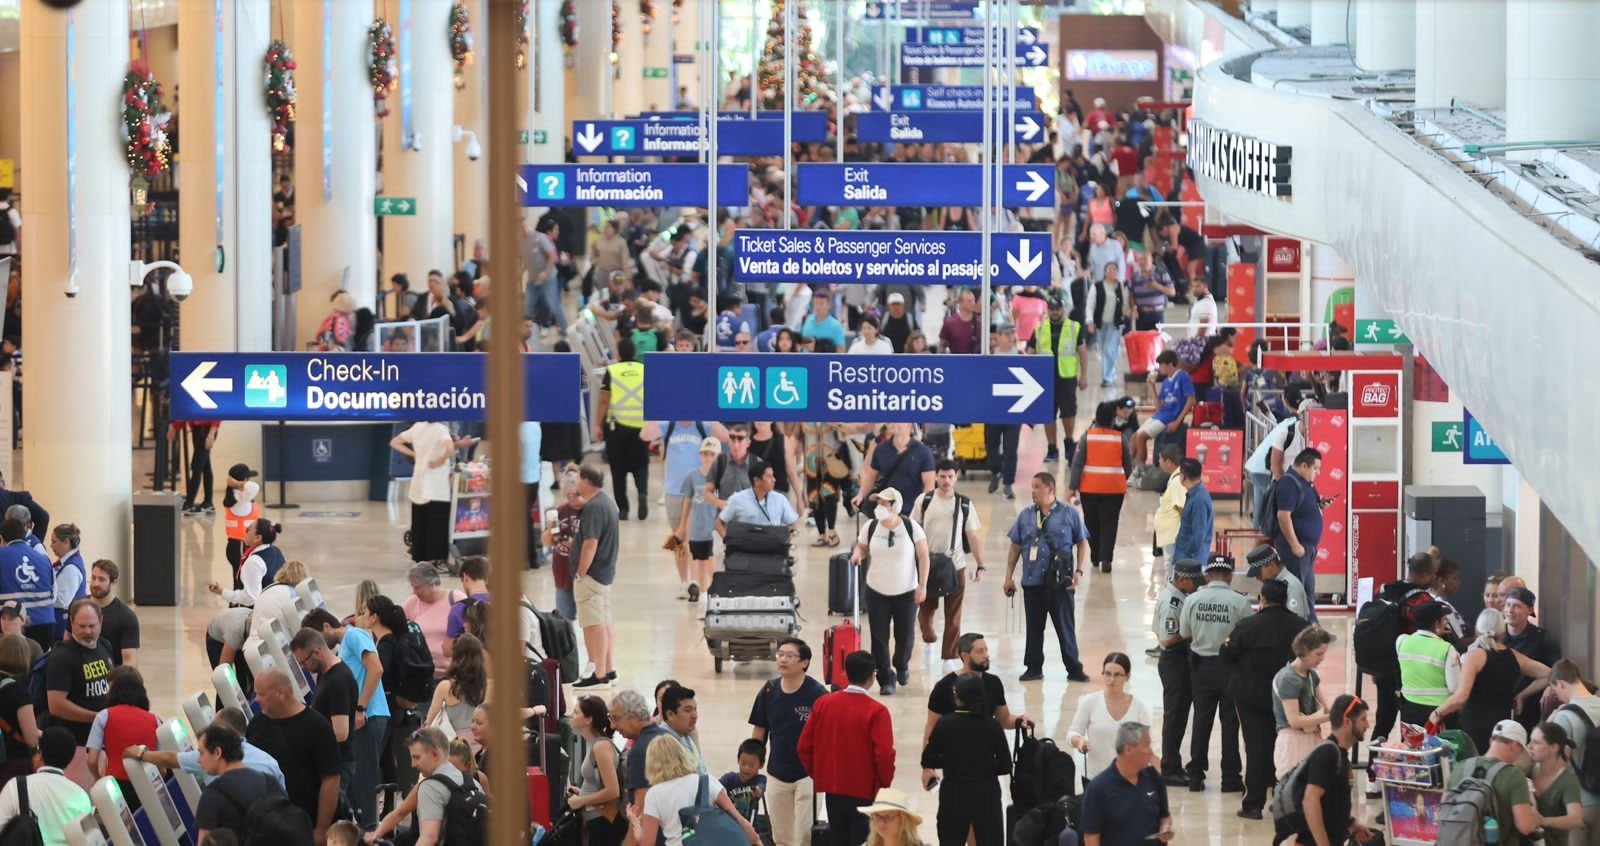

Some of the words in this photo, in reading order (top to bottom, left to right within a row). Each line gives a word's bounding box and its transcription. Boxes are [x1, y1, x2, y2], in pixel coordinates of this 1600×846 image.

[890, 114, 910, 126] Exit
[643, 123, 707, 137] Informatio
[890, 127, 923, 140] Salida
[1229, 134, 1279, 198] COFFEE
[576, 168, 651, 183] Information
[844, 168, 869, 183] Exit
[576, 185, 663, 200] Información
[844, 185, 887, 200] Salida
[739, 236, 776, 253] Ticket
[778, 237, 811, 253] Sales
[814, 238, 825, 253] &
[828, 237, 891, 258] Passenger
[894, 238, 946, 255] Services
[739, 257, 779, 275] Venta
[782, 258, 799, 275] de
[802, 258, 851, 276] boletos
[856, 262, 864, 279] y
[866, 259, 925, 276] servicios
[927, 260, 939, 276] al
[942, 260, 999, 280] pasajeo
[306, 358, 399, 381] Check-In
[828, 360, 945, 383] Restrooms
[306, 386, 486, 410] Documentación
[827, 387, 943, 411] Sanitarios
[1363, 392, 1387, 403] BAG
[1474, 430, 1497, 446] AT
[1198, 602, 1229, 613] GUARDIA
[1196, 612, 1231, 624] NACIONAL
[83, 659, 108, 680] BEER
